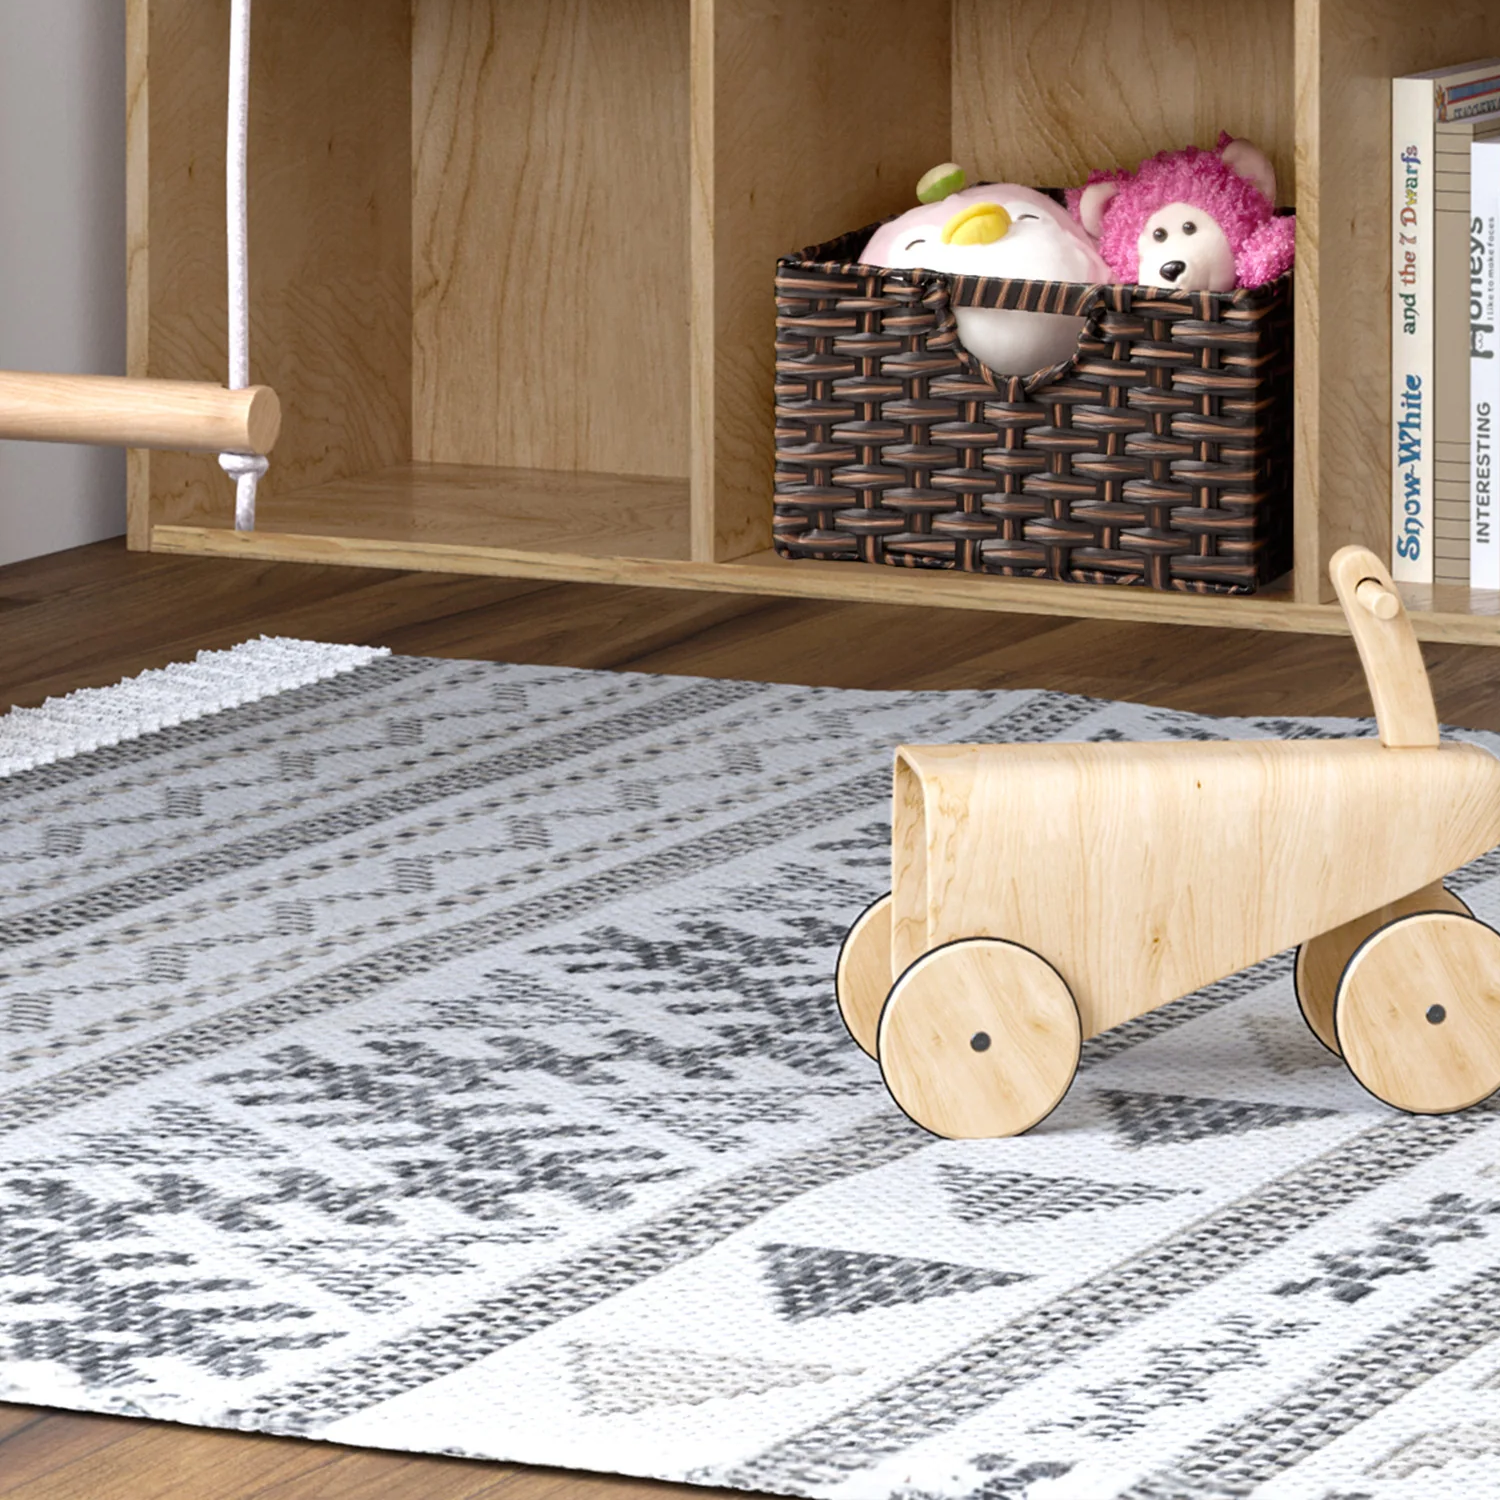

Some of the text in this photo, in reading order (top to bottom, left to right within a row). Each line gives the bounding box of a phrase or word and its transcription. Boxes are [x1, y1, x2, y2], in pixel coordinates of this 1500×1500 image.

[1399, 145, 1421, 227] Dwarfs
[1399, 232, 1417, 247] 7
[1486, 216, 1495, 248] faces
[1398, 251, 1417, 286] the
[1486, 249, 1494, 278] make
[1486, 281, 1494, 293] to
[1398, 293, 1419, 335] and
[1476, 401, 1491, 544] INTERESTING
